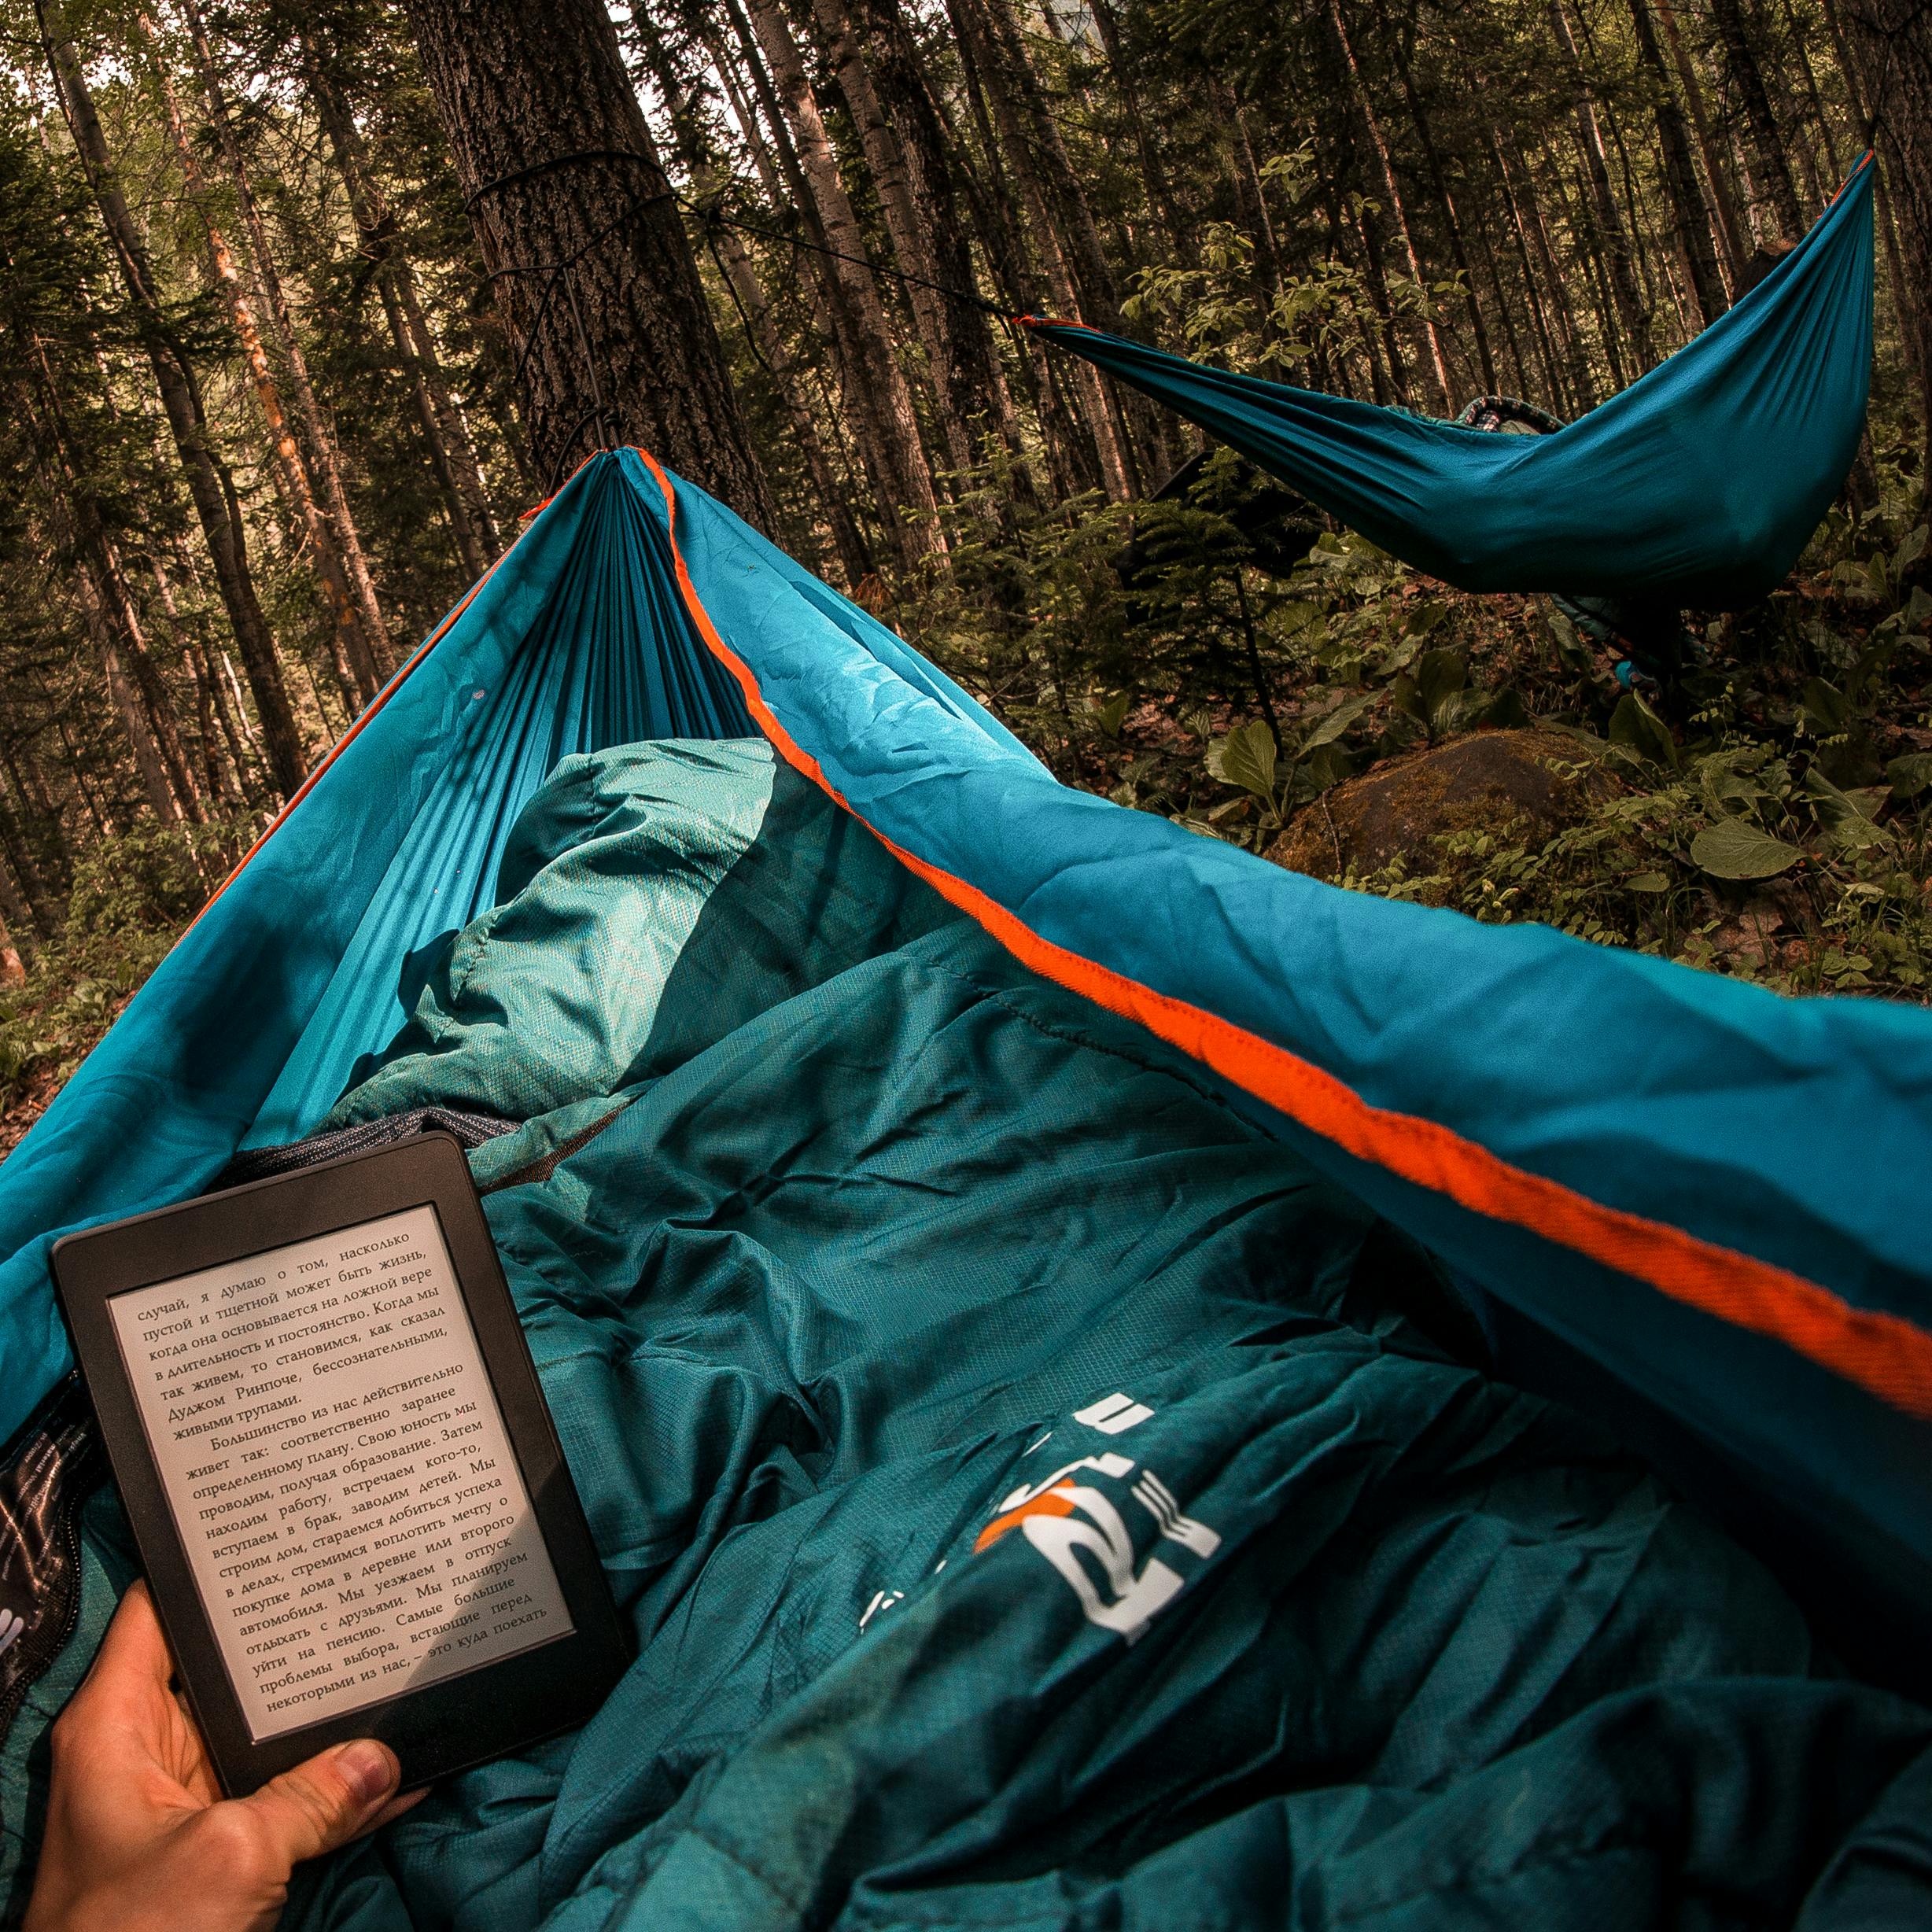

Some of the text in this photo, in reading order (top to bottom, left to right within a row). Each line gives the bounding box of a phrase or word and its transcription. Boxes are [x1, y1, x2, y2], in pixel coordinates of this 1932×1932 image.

[138, 1233, 410, 1322] случай, я думаю о том, насколько
[142, 1251, 426, 1343] пустой и тщетной может быть жизнь,
[149, 1268, 433, 1362] когда она основывается на ложной вере
[154, 1287, 440, 1381] в длительность и постоянство. Когда мы
[160, 1307, 445, 1401] так живем, то становимся, как сказал
[168, 1328, 448, 1424] Дуджом Ринпоче, бессознательными,
[172, 1395, 302, 1441] живыми трупами.
[186, 1388, 455, 1480] живет так: соответственно заранее
[193, 1401, 477, 1499] определенному плану. Свою юность мы
[209, 1364, 463, 1451] Большинство из нас действительно
[198, 1421, 483, 1521] проводим, получая образование. Затем
[205, 1444, 481, 1539] находим работу, встречаем кого-то,
[212, 1458, 496, 1559] вступаем в брак, заводим детей. Мы
[219, 1478, 503, 1578] строим дом, стараемся добиться успеха
[225, 1497, 508, 1598] в делах, стремимся воплотить мечту о
[232, 1516, 514, 1617] покупке дома в деревне или второго
[239, 1537, 512, 1636] автомобиля. Мы уезжаем в отпуск
[245, 1552, 529, 1655] отдыхать с друзьями. Мы планируем
[252, 1578, 515, 1679] уйти на пенсию. Самые большие
[259, 1594, 533, 1694] проблемы выбора, встающие перед
[266, 1676, 356, 1713] некоторыми
[359, 1669, 377, 1682] из
[382, 1658, 411, 1674] нас,
[427, 1643, 452, 1657] это
[456, 1630, 489, 1649] куда
[492, 1609, 548, 1635] поехать
